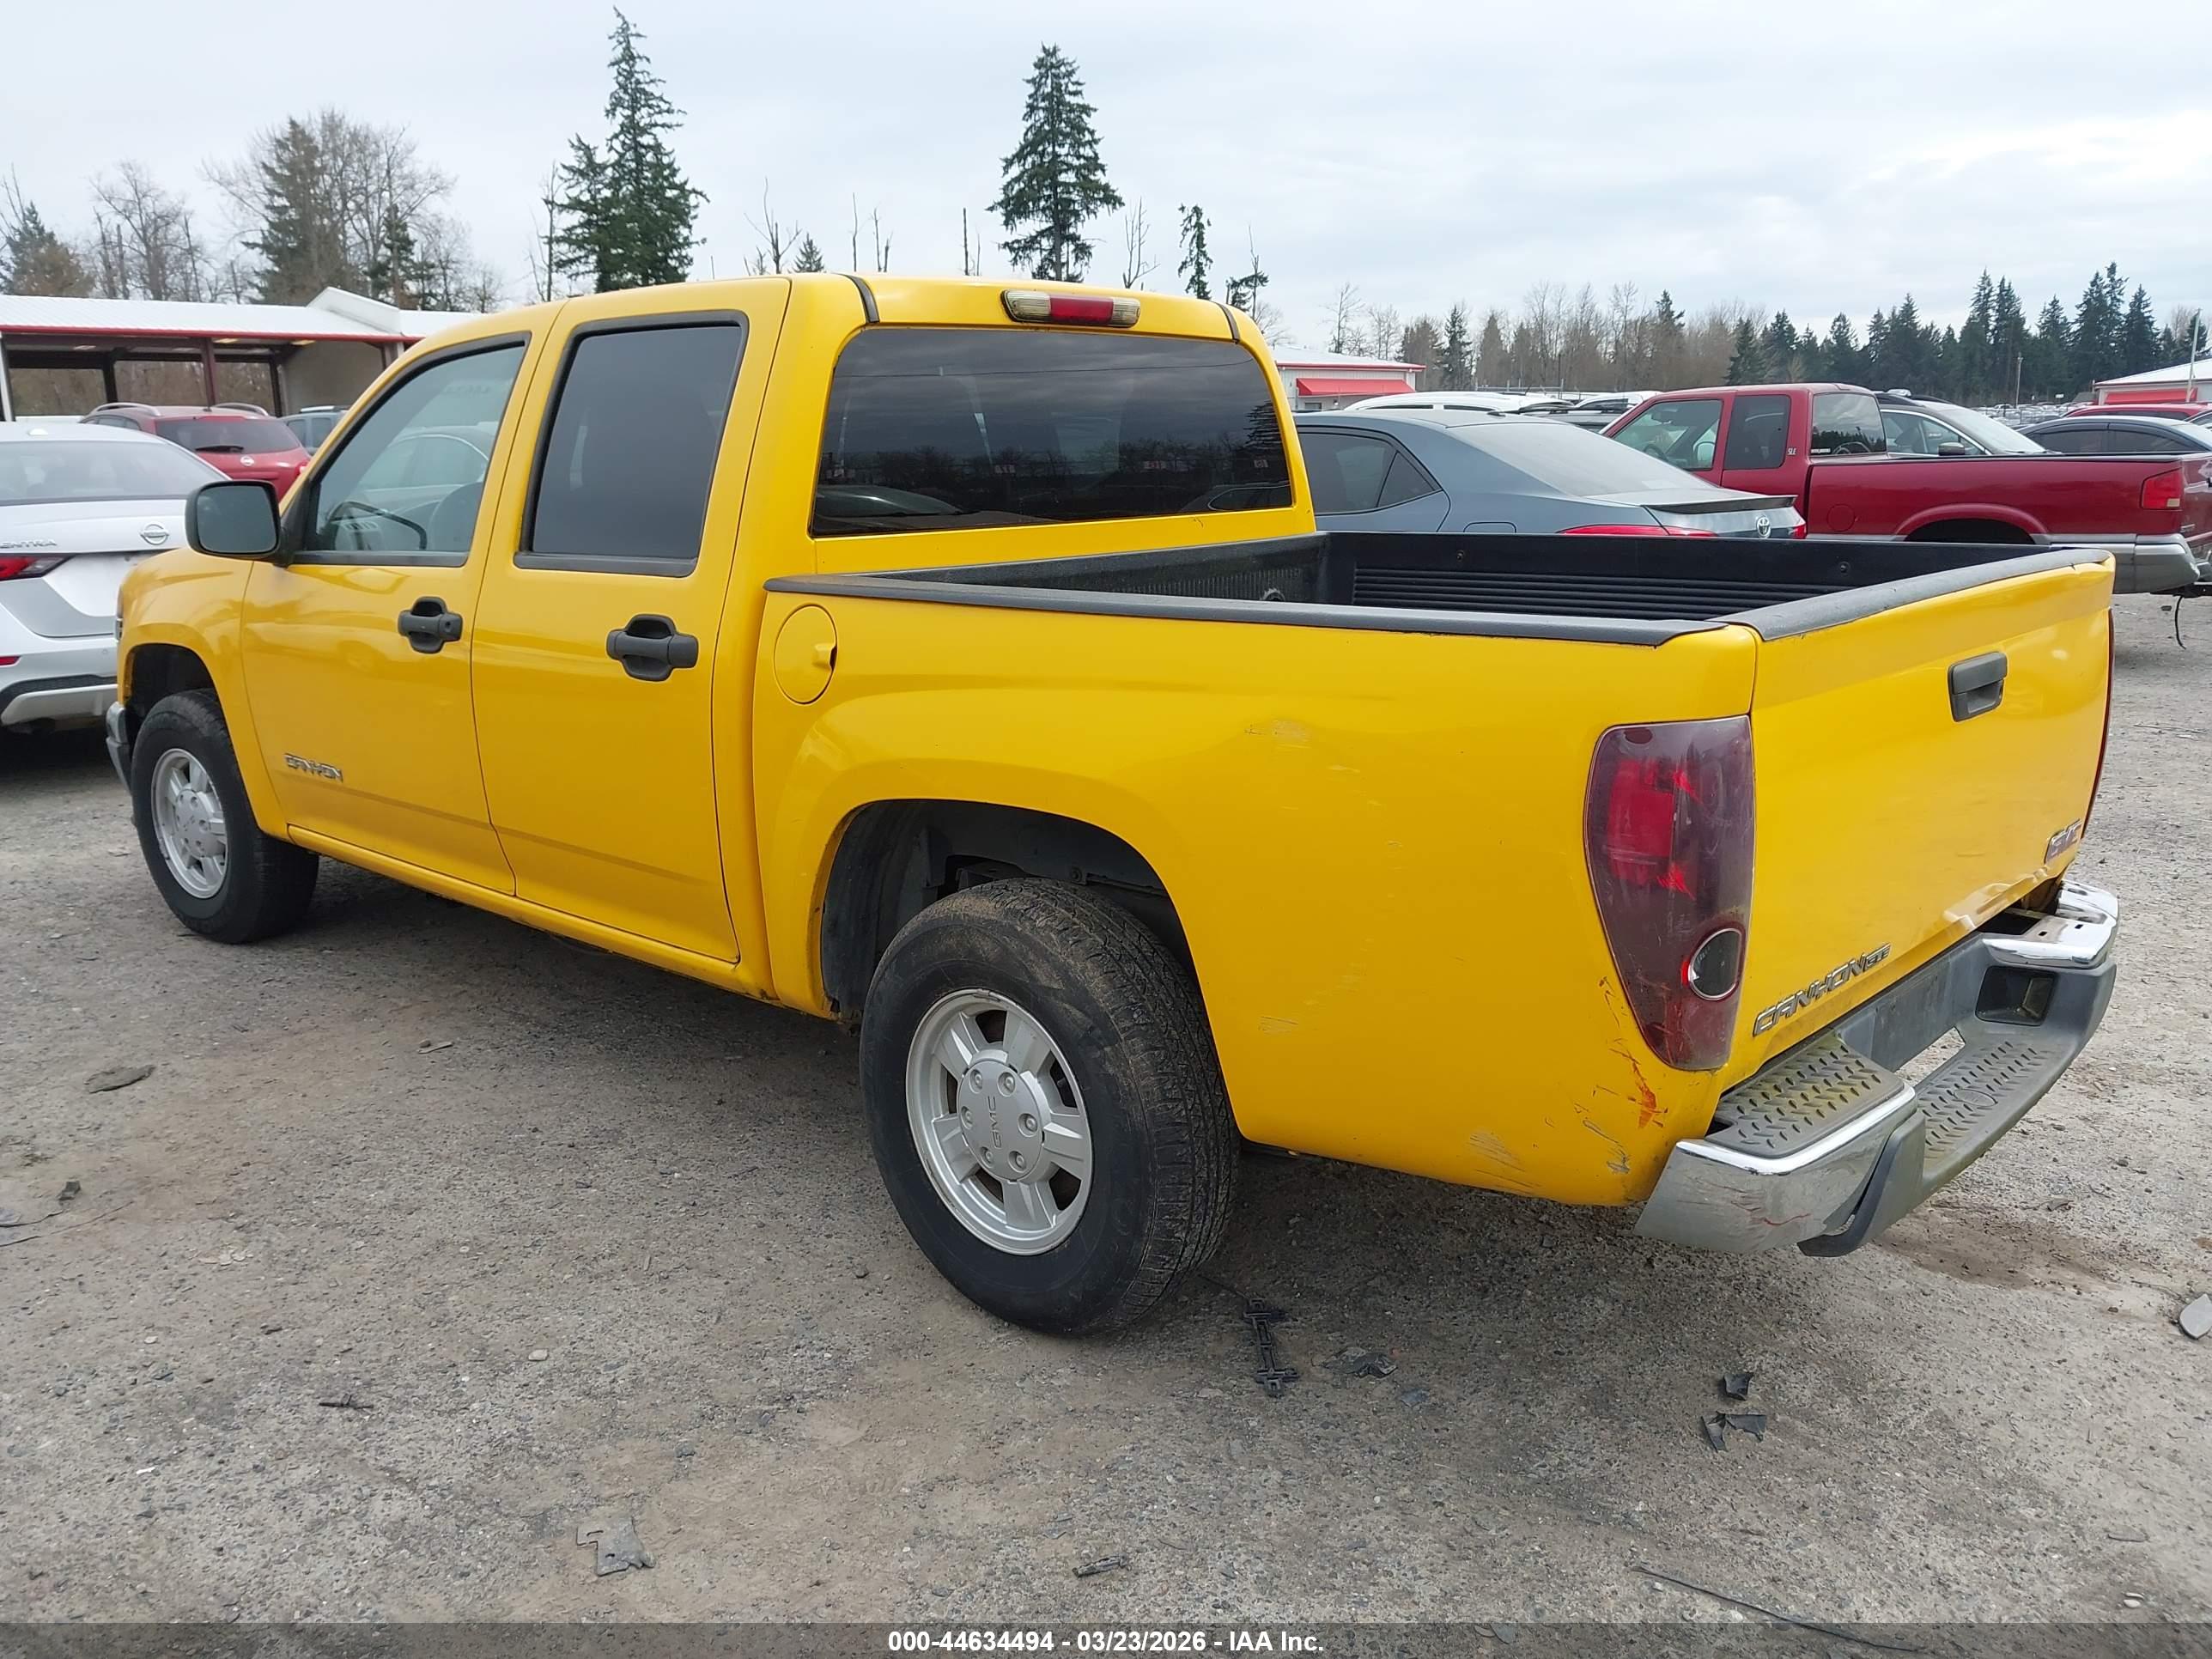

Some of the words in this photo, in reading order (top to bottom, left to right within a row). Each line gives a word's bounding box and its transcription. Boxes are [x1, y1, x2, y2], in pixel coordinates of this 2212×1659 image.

[284, 752, 343, 783] CANYON
[2044, 818, 2082, 864] GMC
[1753, 955, 1866, 1037] CANYON
[988, 1096, 1003, 1150] GMC
